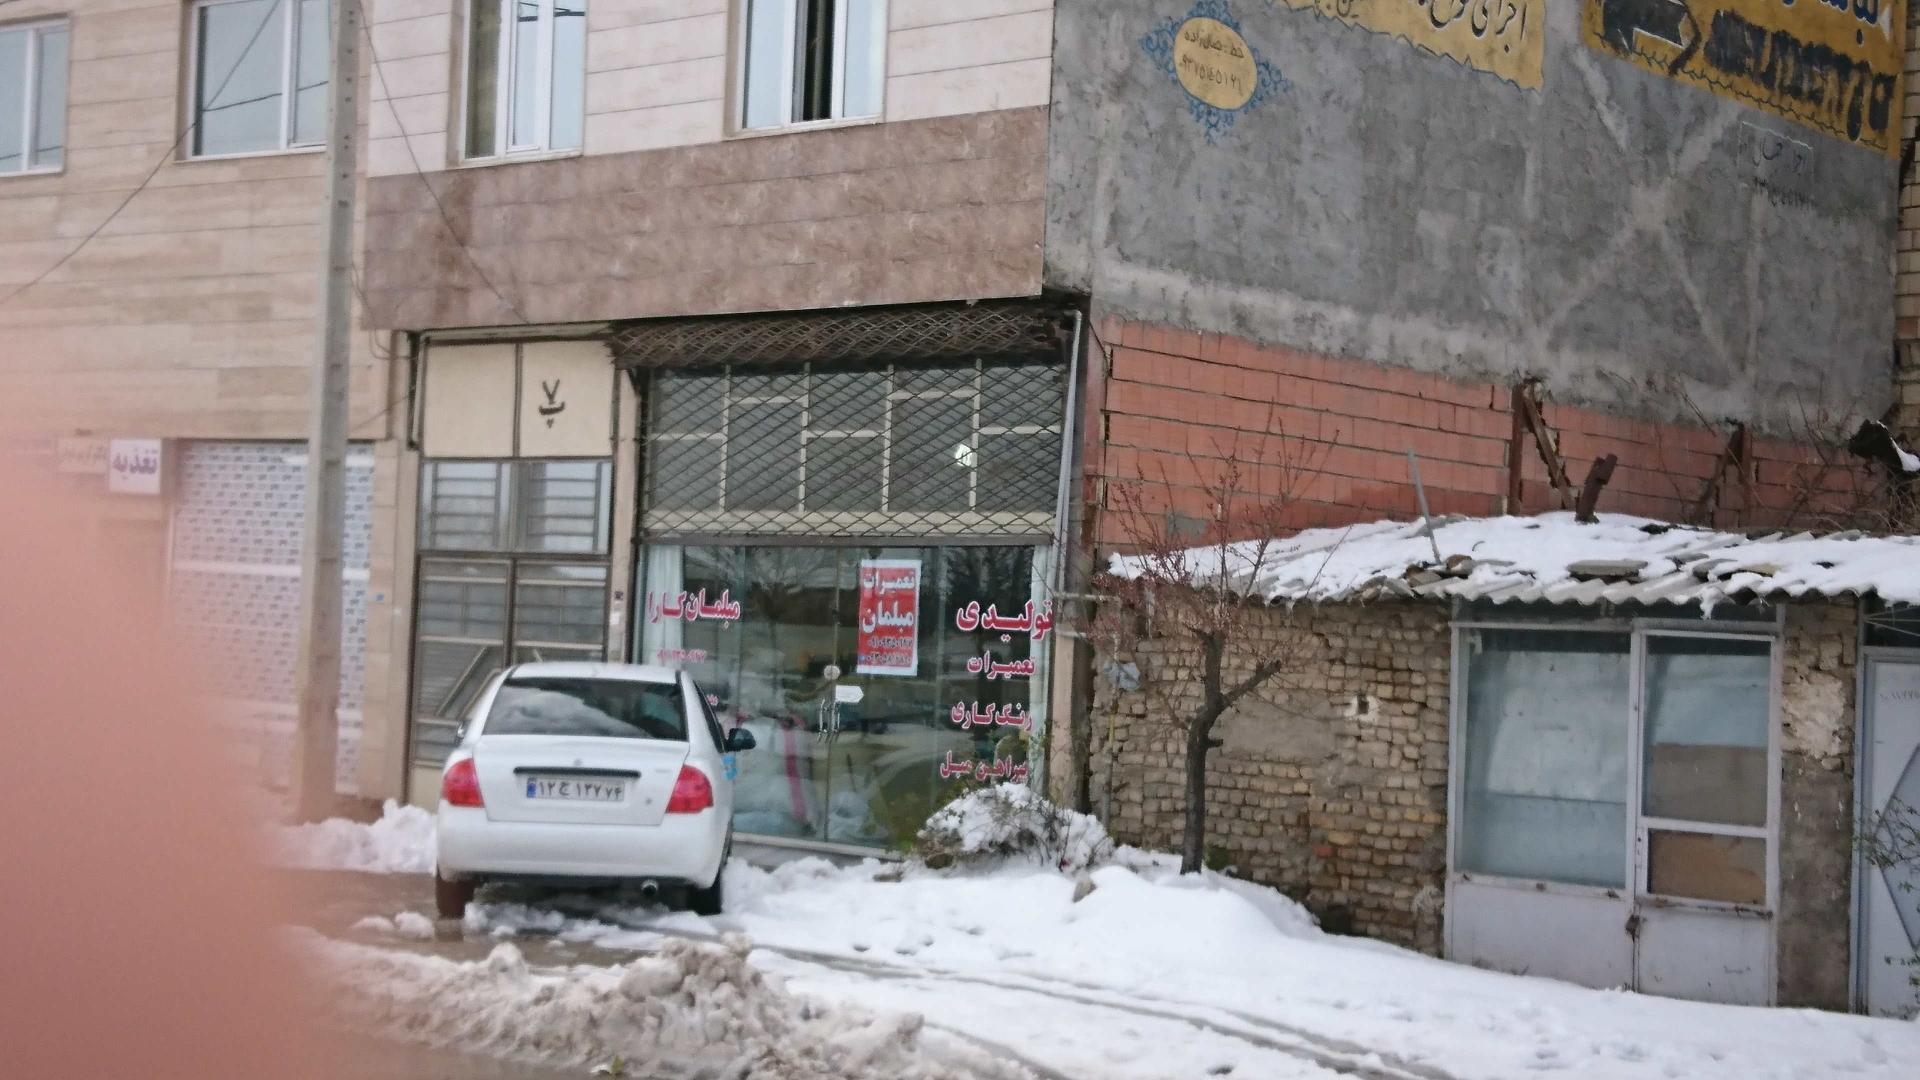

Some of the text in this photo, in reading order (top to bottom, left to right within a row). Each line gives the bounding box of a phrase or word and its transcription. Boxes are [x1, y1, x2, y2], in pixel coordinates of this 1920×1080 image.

[863, 568, 915, 595] تعمیرات
[684, 587, 741, 630] مبلمان
[862, 600, 914, 634] مبلمان
[956, 599, 1054, 642] تولیدی
[966, 650, 1035, 679] تعمیرات
